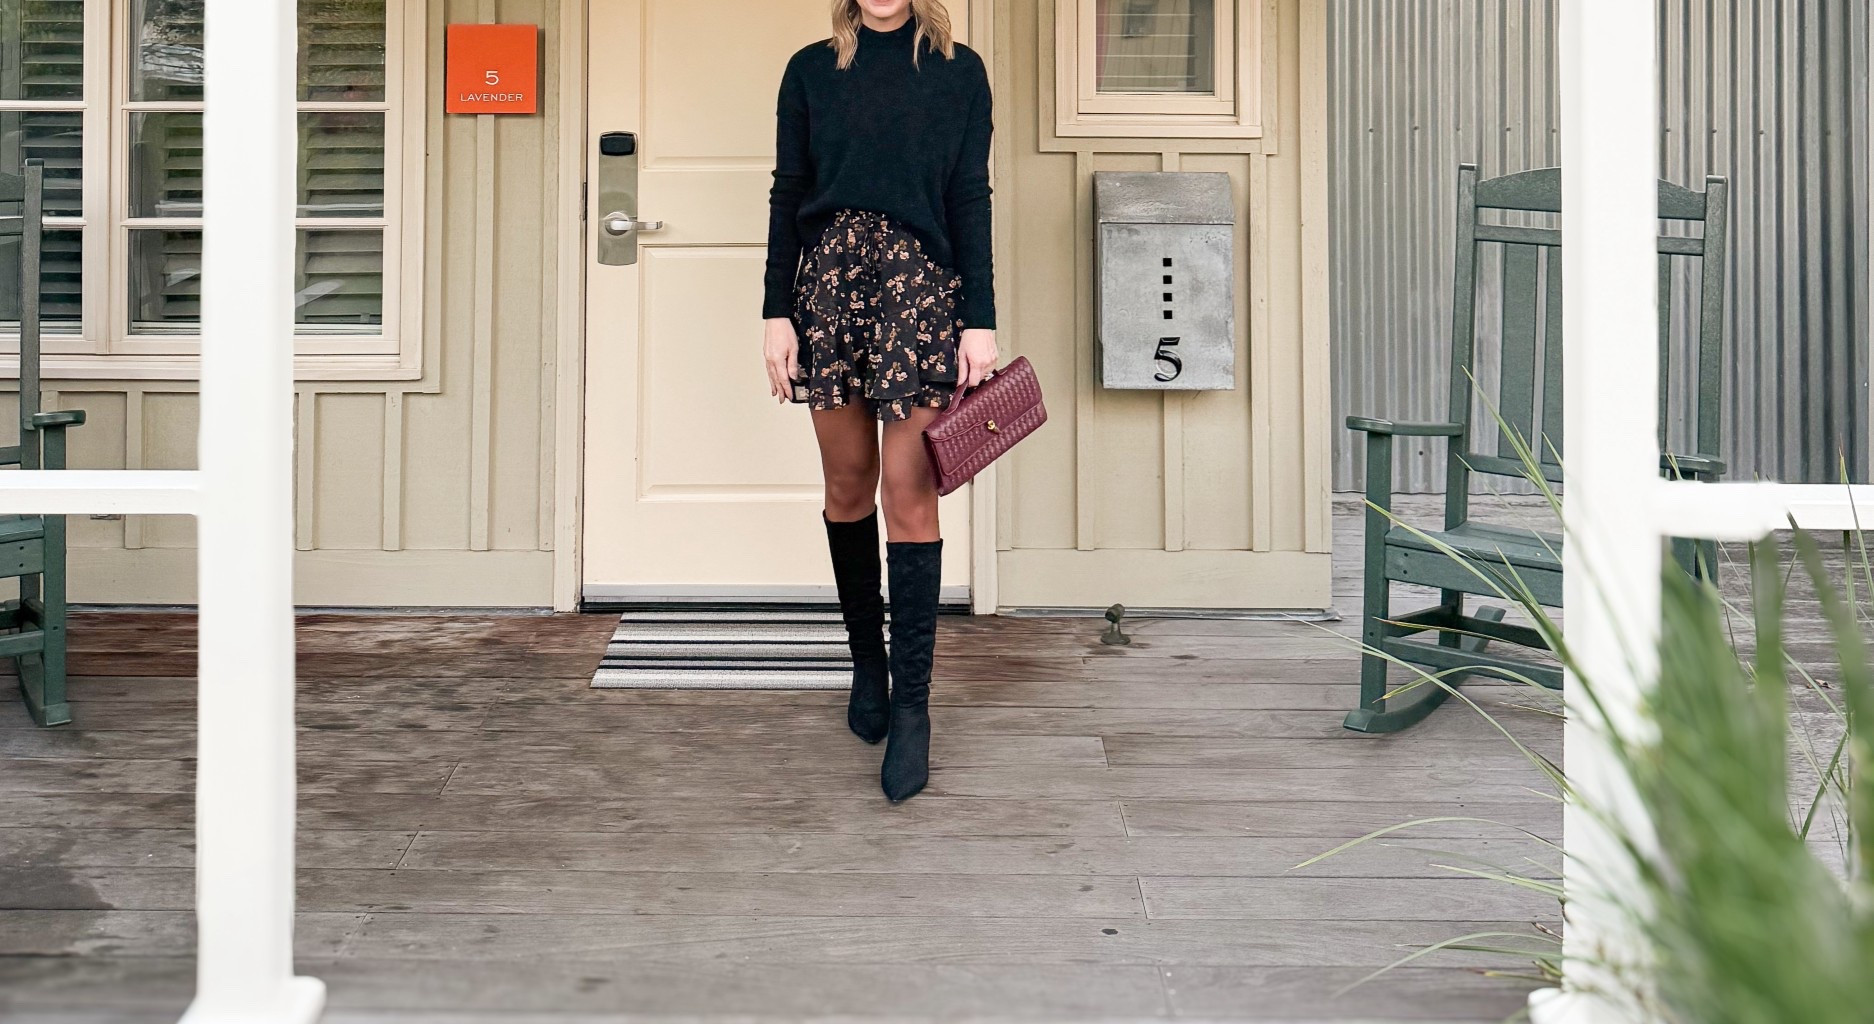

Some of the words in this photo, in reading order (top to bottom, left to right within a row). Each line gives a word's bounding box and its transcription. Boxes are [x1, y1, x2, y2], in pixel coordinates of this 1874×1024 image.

[485, 70, 499, 86] 5
[460, 93, 523, 102] LAVENDER
[1153, 336, 1183, 382] 5
